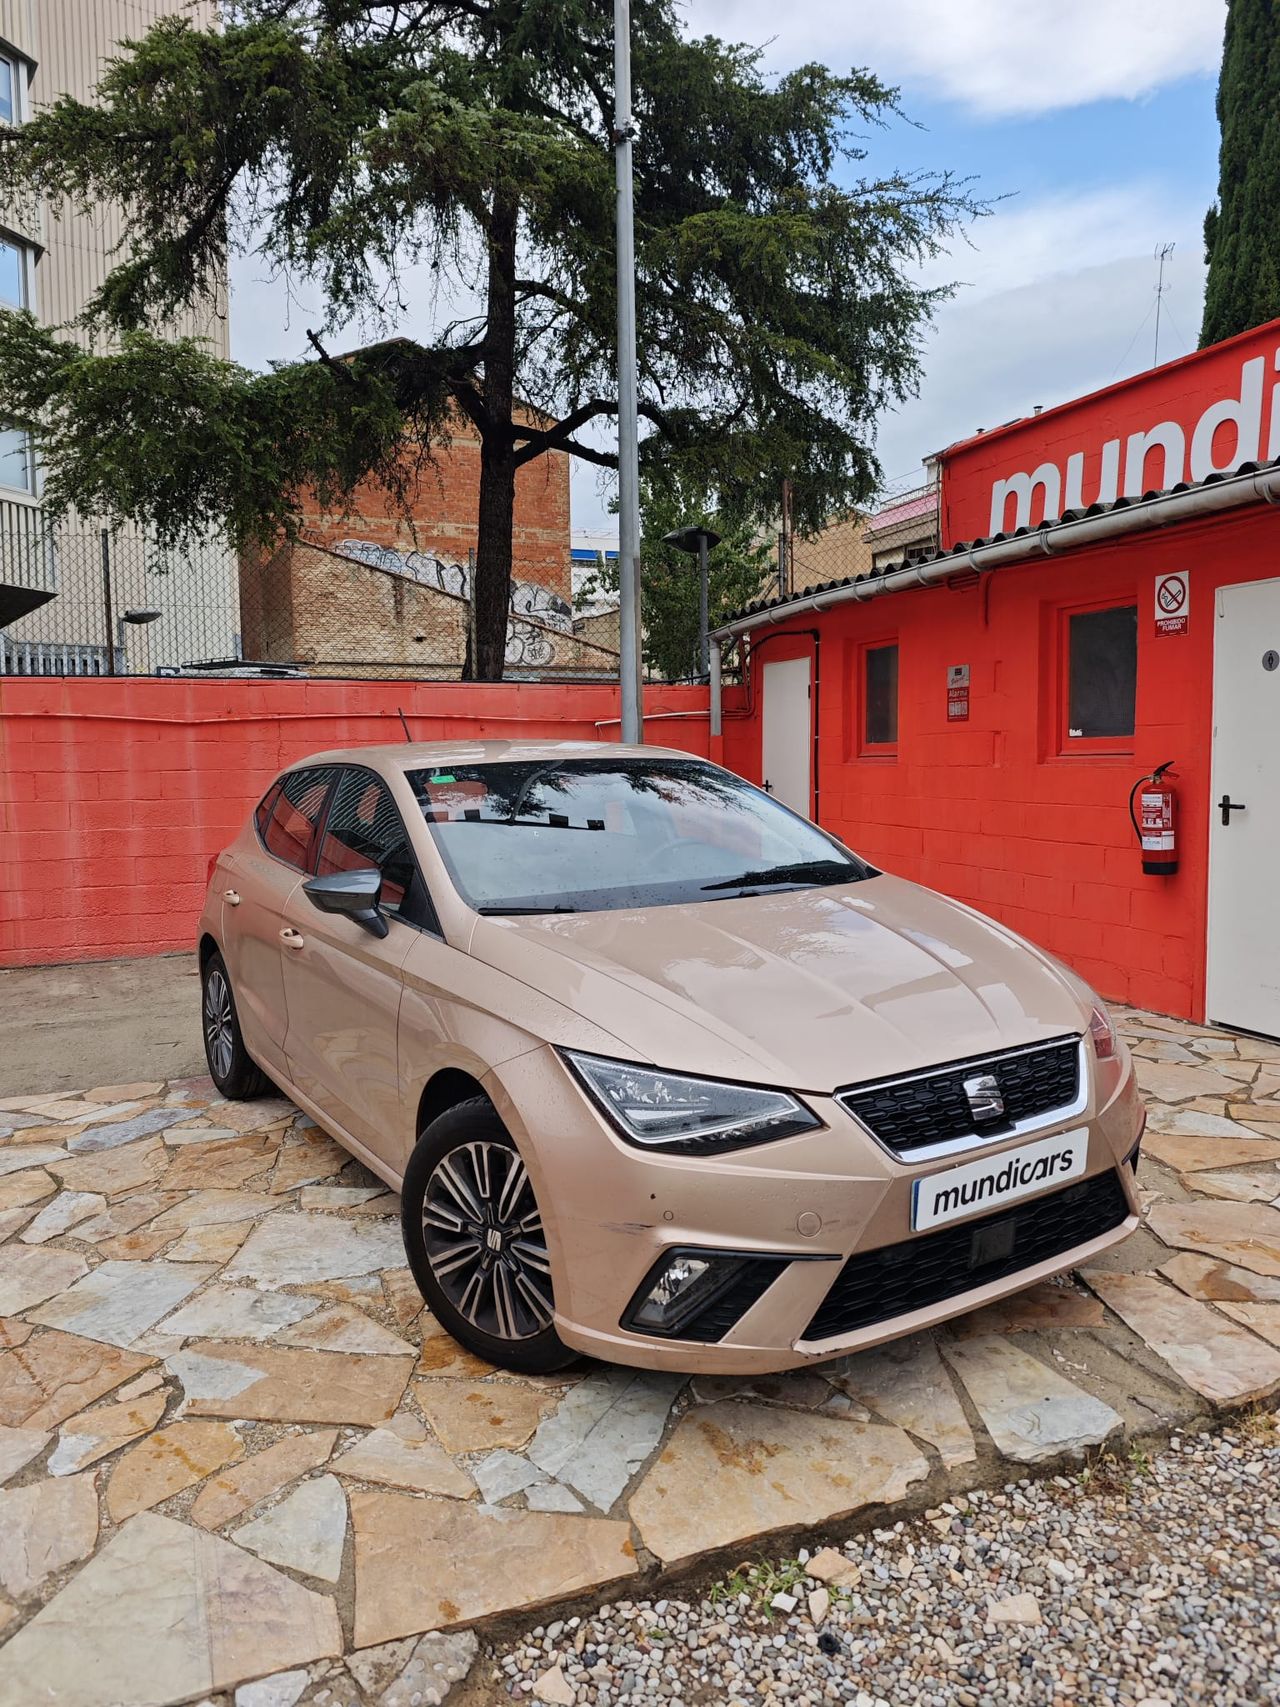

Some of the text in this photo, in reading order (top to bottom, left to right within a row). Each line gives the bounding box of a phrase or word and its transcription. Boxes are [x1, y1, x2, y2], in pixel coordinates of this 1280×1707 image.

[1157, 618, 1185, 627] PROHIBIDO
[1162, 623, 1182, 631] FUMAR
[933, 1149, 1074, 1216] mundicars
